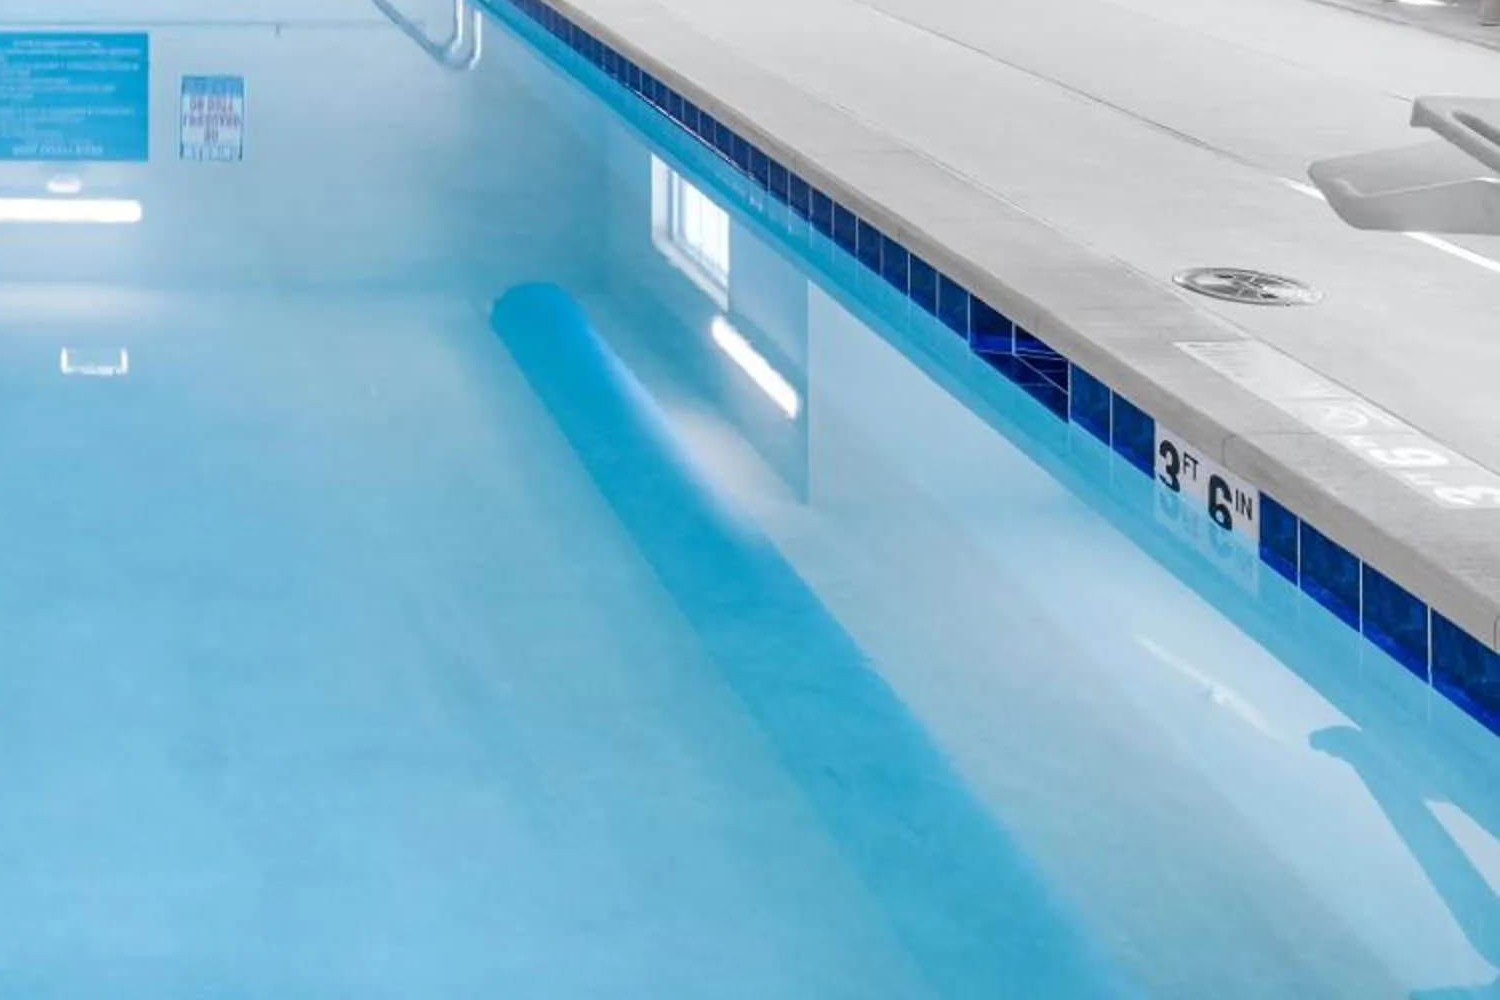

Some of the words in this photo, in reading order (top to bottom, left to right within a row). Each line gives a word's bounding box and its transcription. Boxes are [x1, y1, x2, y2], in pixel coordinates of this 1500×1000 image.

[1158, 439, 1181, 493] 3
[1182, 450, 1200, 482] FT
[1207, 473, 1233, 531] 6
[1234, 488, 1253, 521] IN
